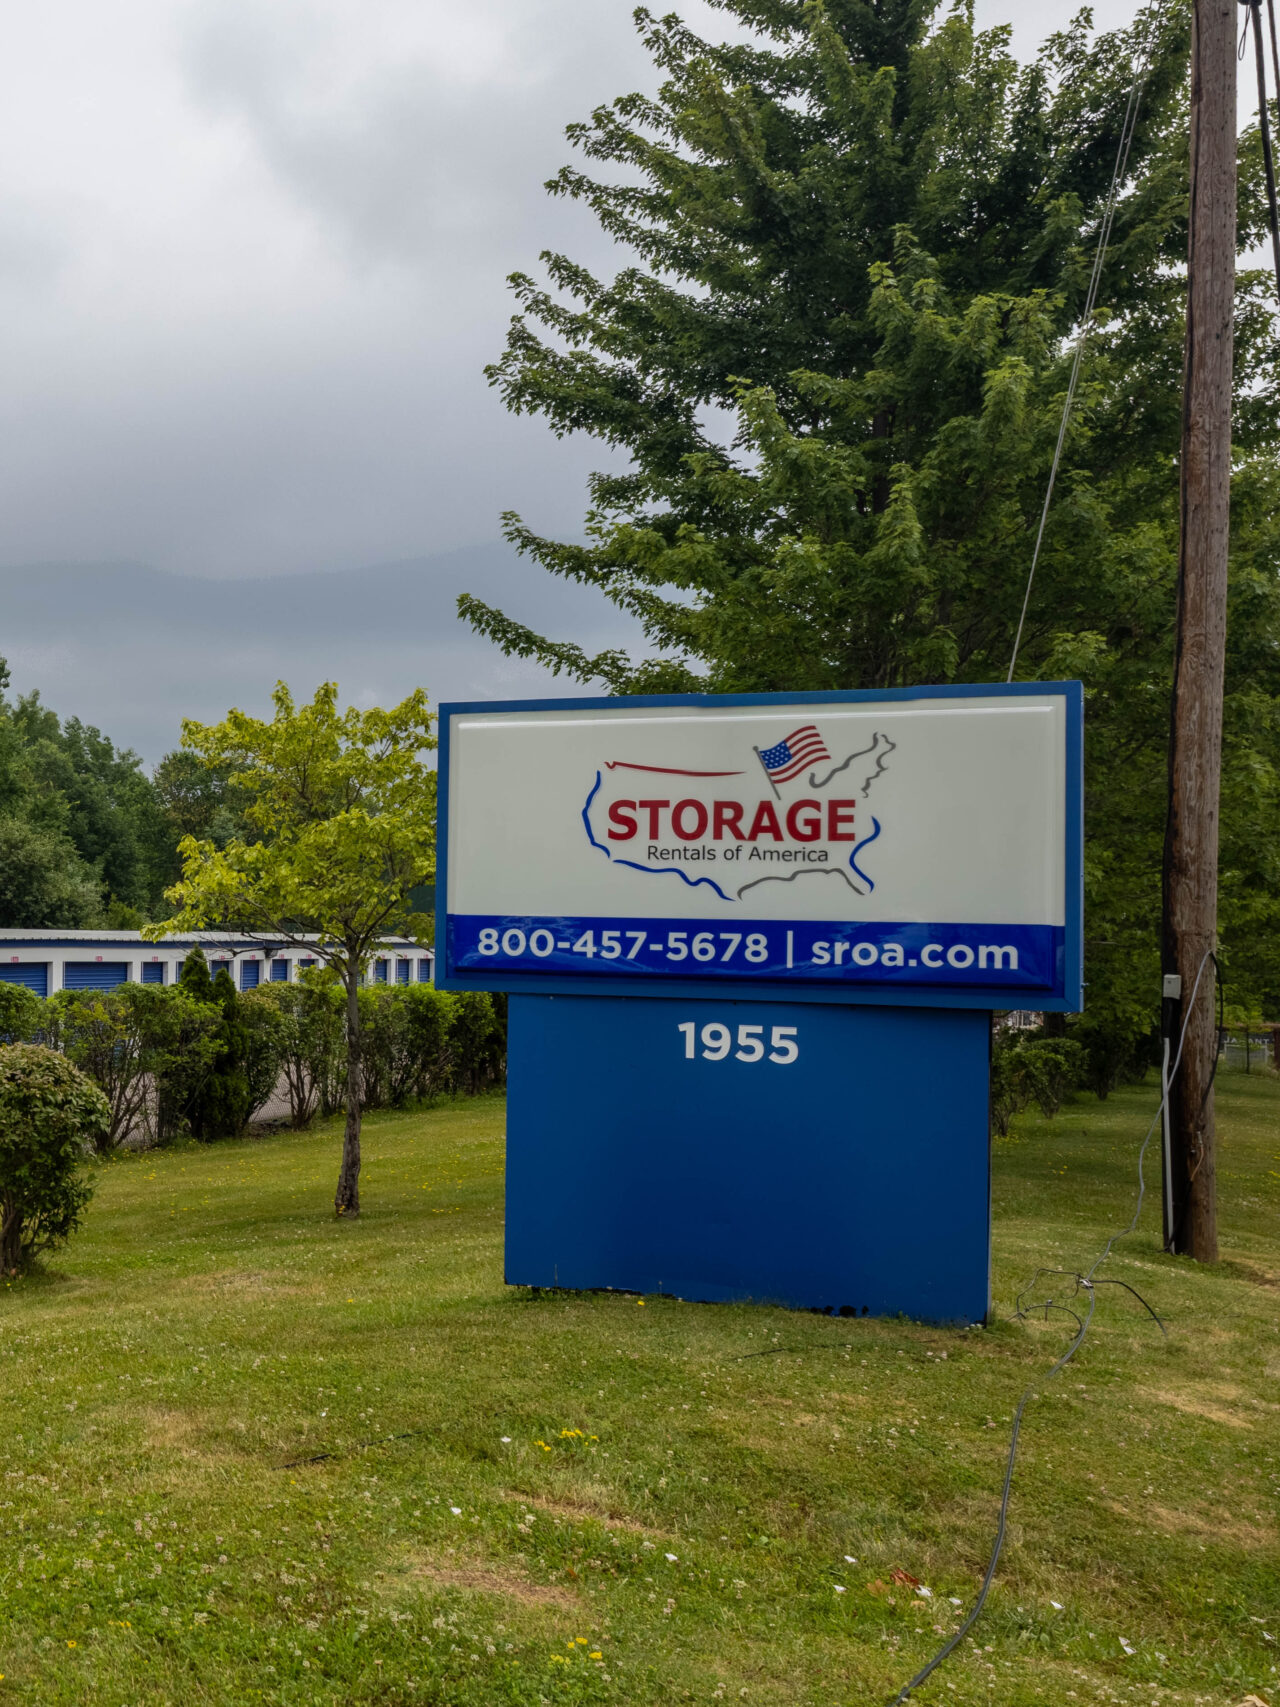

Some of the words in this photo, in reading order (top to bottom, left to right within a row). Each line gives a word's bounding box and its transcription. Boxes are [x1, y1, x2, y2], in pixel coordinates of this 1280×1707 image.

[607, 798, 856, 843] STORAGE
[647, 845, 717, 861] Rentals
[723, 845, 743, 861] of
[748, 846, 829, 862] America
[477, 927, 769, 963] 800-457-5678
[811, 941, 1019, 970] sroa.com
[678, 1022, 799, 1064] 1955
